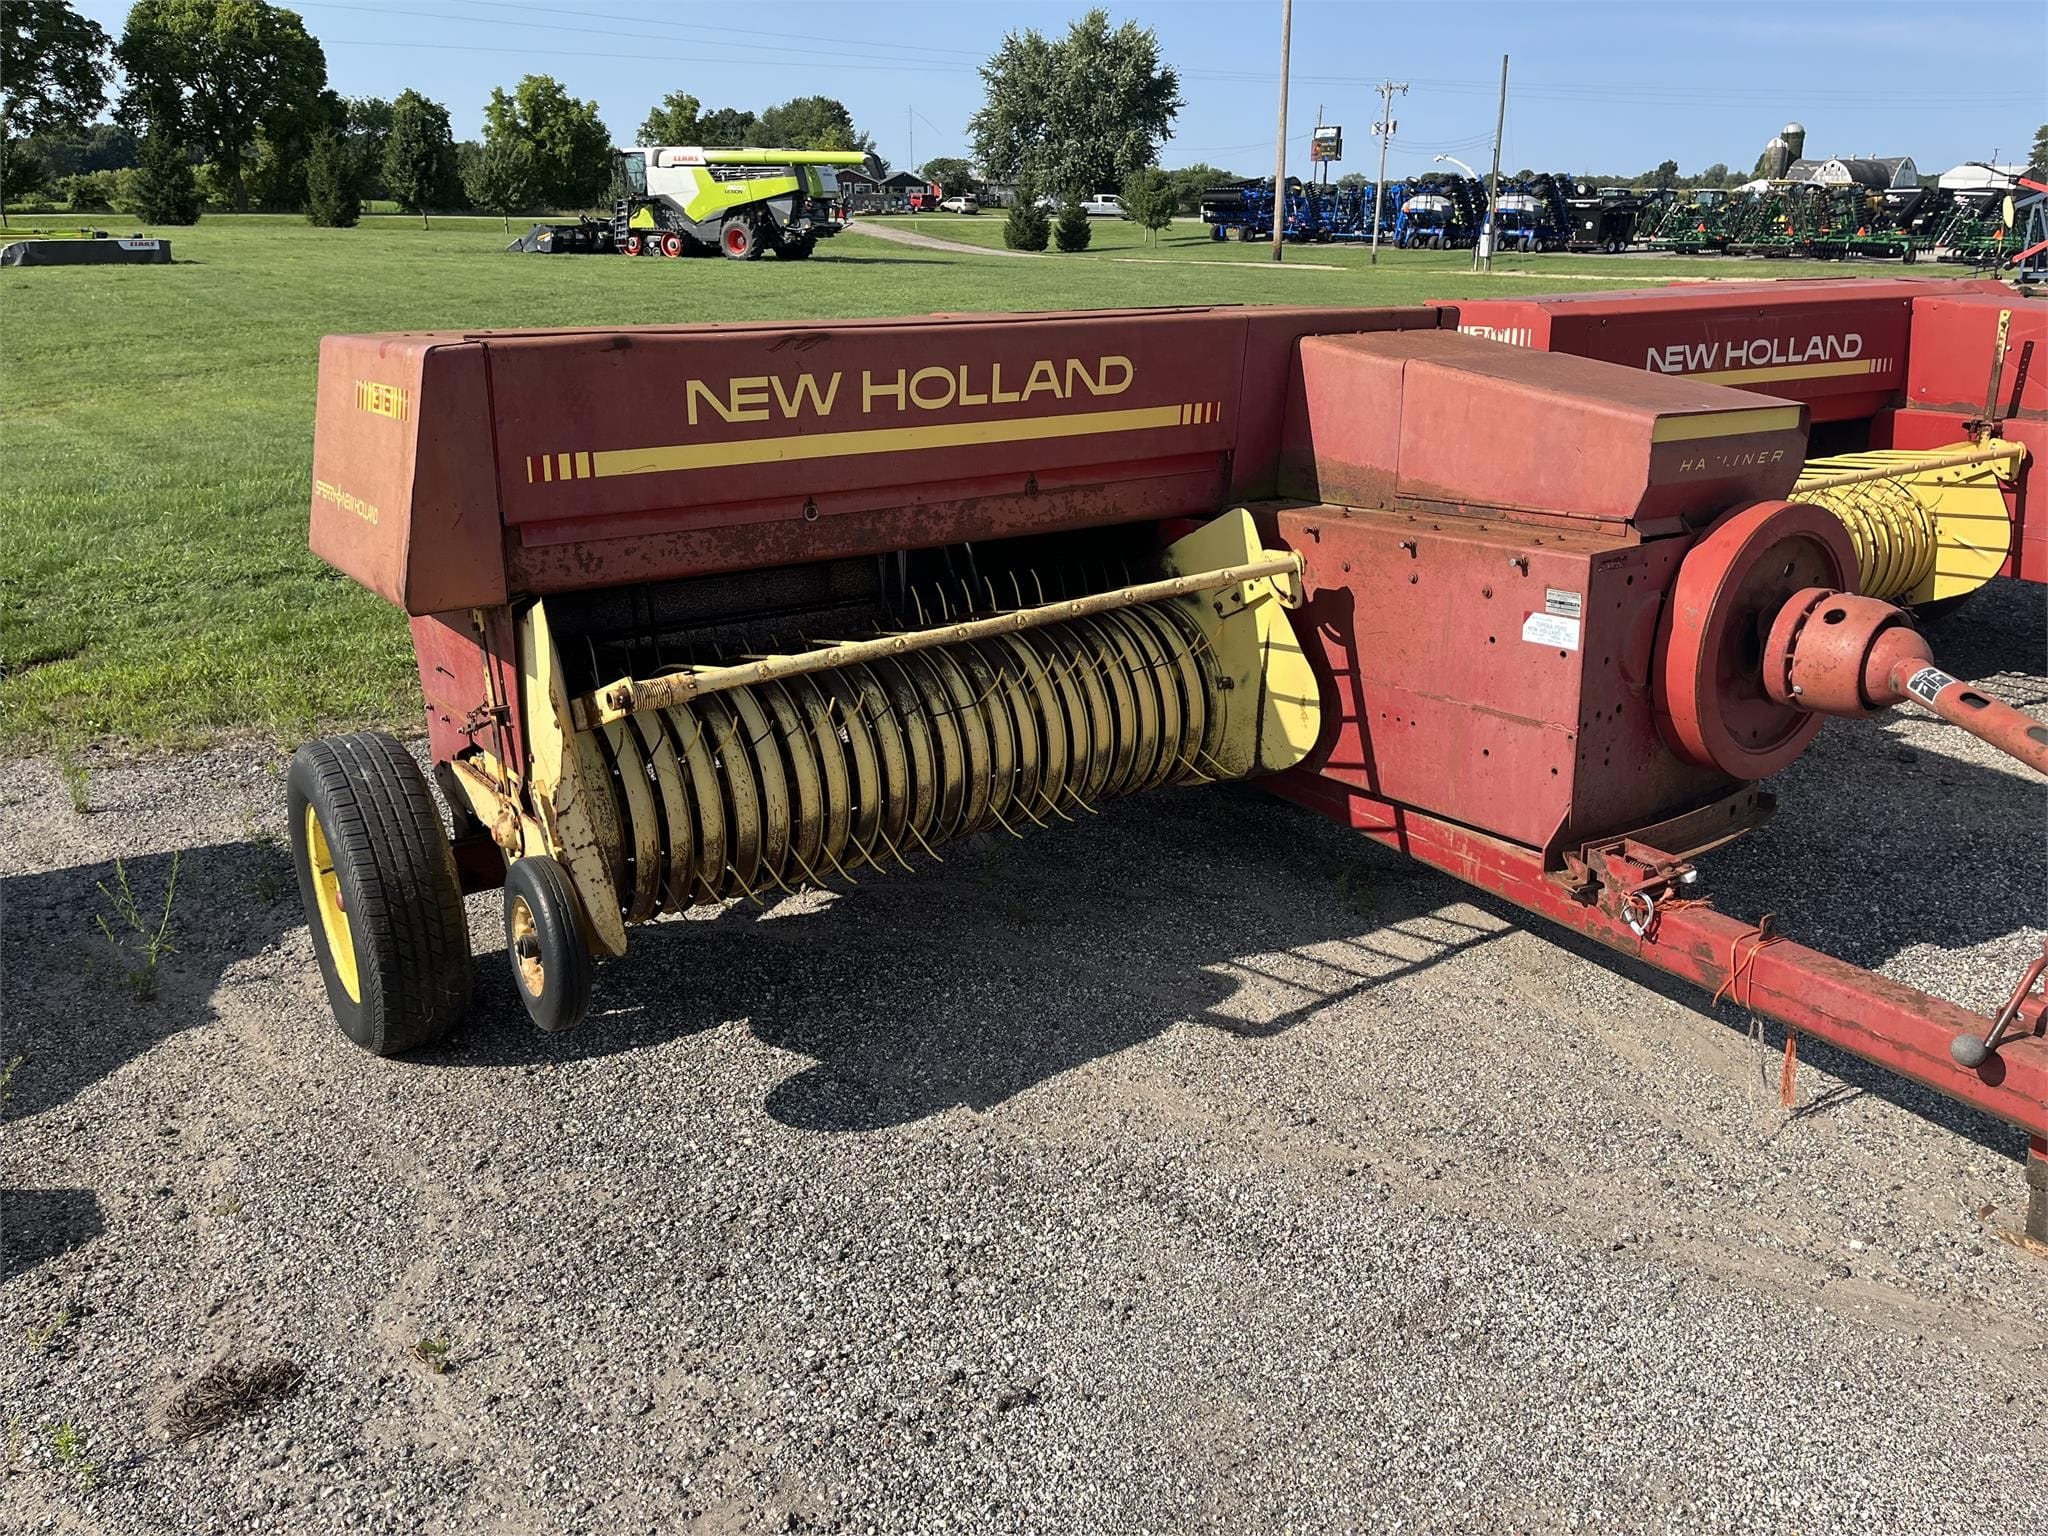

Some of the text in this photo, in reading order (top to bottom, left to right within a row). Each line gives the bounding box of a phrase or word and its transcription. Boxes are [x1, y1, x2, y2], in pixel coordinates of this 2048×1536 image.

[1646, 333, 1863, 373] NEW HOLLAND
[686, 355, 1134, 425] NEW HOLLAND
[1680, 450, 1784, 472] HALINER
